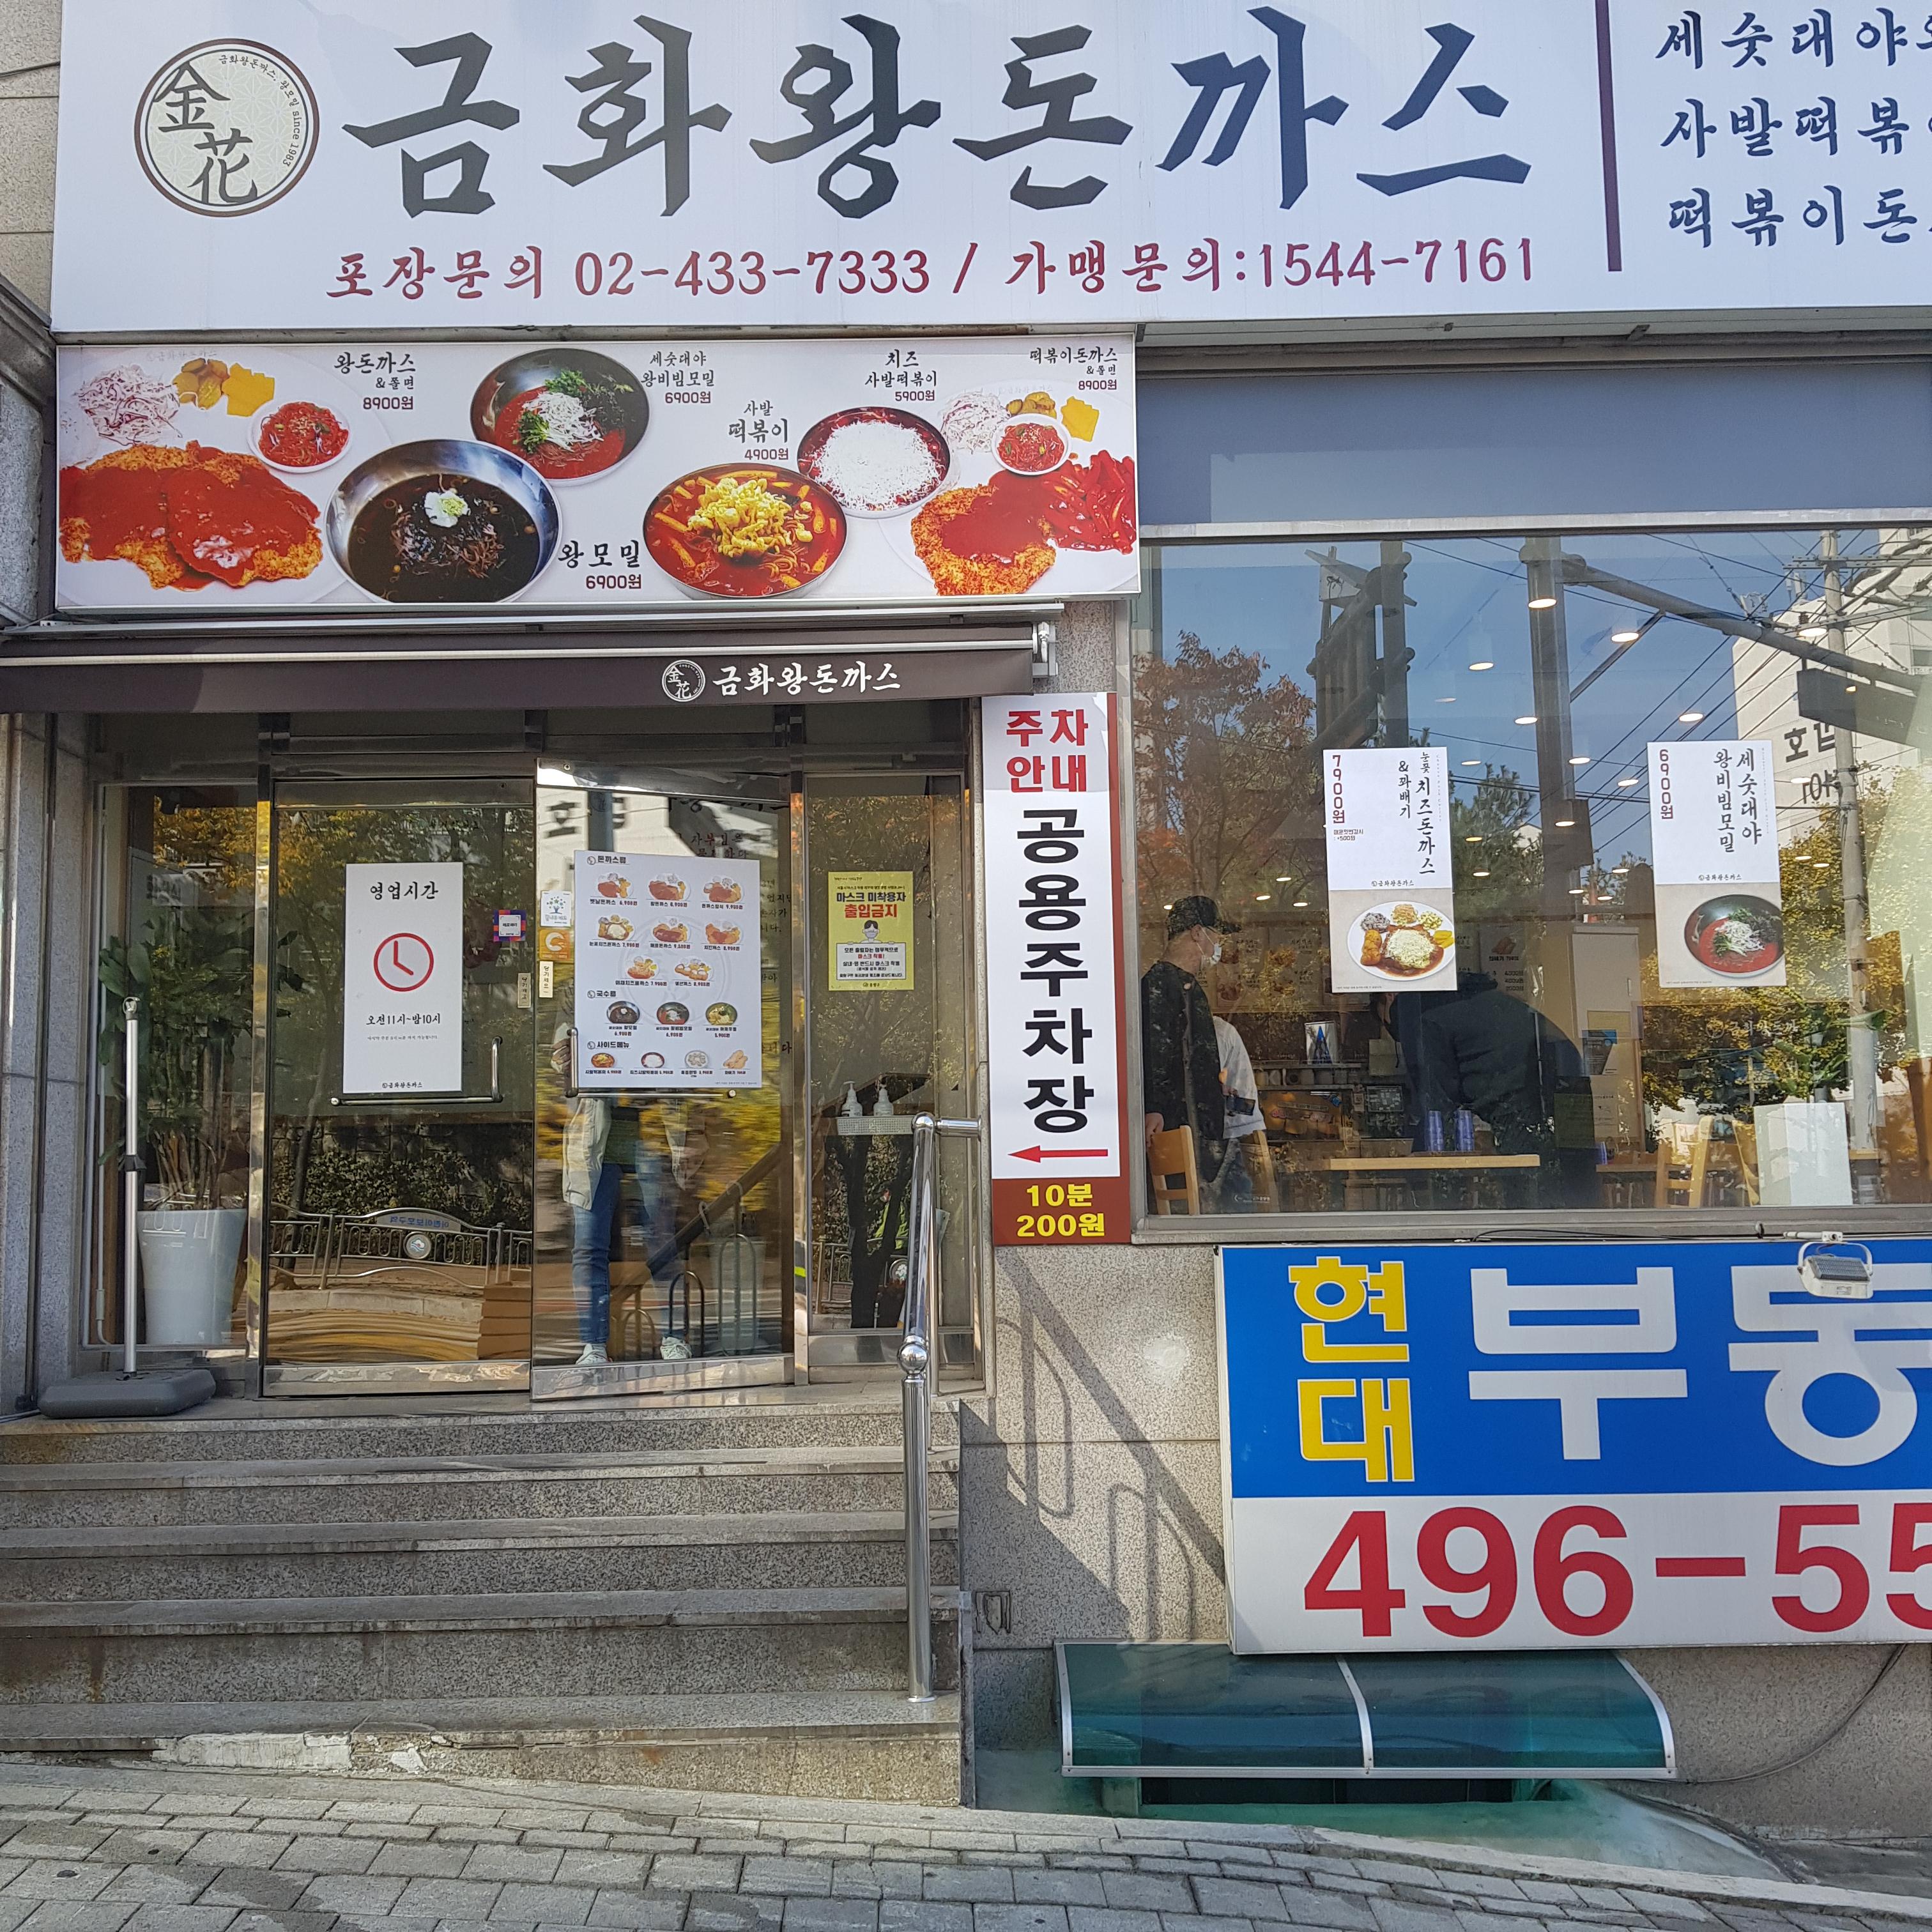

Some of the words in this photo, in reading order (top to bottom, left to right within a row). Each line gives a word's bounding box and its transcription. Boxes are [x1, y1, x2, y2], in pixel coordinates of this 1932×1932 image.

[342, 6, 1531, 218] 금화왕돈까스
[153, 61, 257, 204] 金花
[292, 111, 302, 140] since
[1660, 96, 1932, 158] 사발떡볶
[282, 142, 299, 167] 1983
[1668, 185, 1932, 248] 떡볶이돈
[326, 245, 542, 300] 포장문의
[575, 249, 930, 296] 02-433-7333
[1005, 237, 1532, 295] 가맹문의:1544-7161
[334, 351, 416, 374] 왕돈까스
[649, 350, 707, 367] 세숫대야
[884, 349, 919, 369] 치즈
[1029, 346, 1118, 364] 떡볶이돈까스
[640, 369, 715, 388] 왕비빔모밀
[864, 371, 937, 388] 사발떡볶이
[1078, 379, 1117, 391] 8900원
[362, 395, 414, 410] 8900원
[664, 391, 712, 404] 6900원
[744, 400, 774, 417] 사발
[894, 390, 935, 402] 5900원
[728, 418, 788, 443] 떡볶이
[744, 447, 789, 461] 4900원
[558, 539, 641, 568] 왕모밀
[585, 574, 641, 589] 6900원
[712, 661, 901, 696] 금화왕돈까스
[1006, 709, 1088, 747] 주차
[1006, 755, 1087, 793] 안내
[1420, 752, 1430, 773] 눈꽃
[1332, 755, 1345, 824] 7900원
[1659, 749, 1673, 820] 6900원
[1736, 748, 1762, 845] 세숫대야
[1713, 748, 1735, 852] 왕비빔모밀
[1416, 777, 1436, 874] 치즈돈까스
[370, 880, 439, 900] 영업시간
[836, 892, 864, 903] 마스크
[868, 891, 907, 903] 미착용자
[845, 903, 898, 918] 출입금지
[1017, 809, 1094, 1133] 공용주차장
[1027, 1183, 1093, 1207] 10분
[1016, 1213, 1105, 1238] 200원
[1288, 1256, 1414, 1482] 현대
